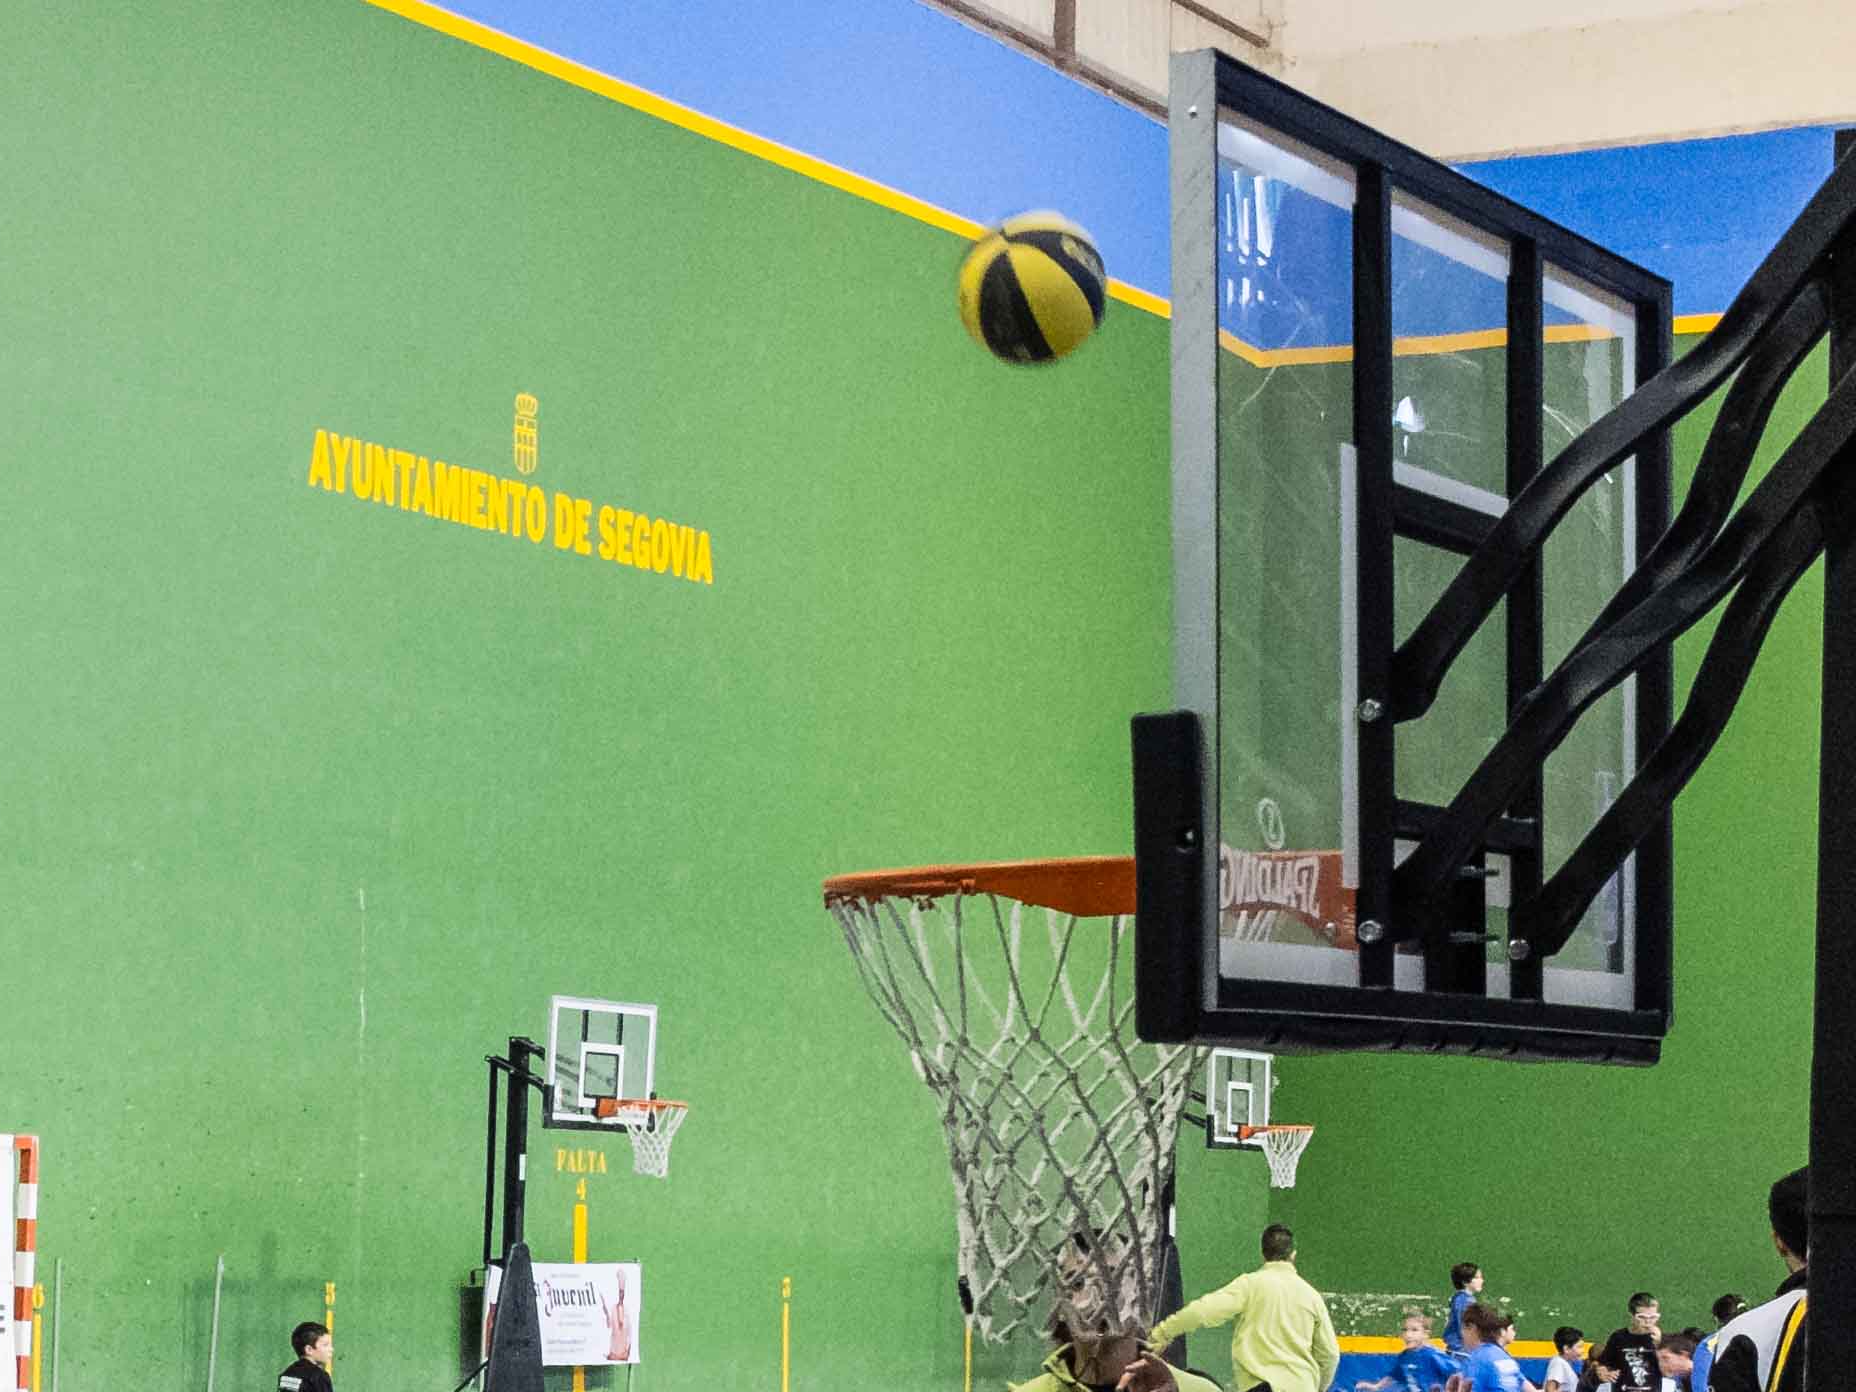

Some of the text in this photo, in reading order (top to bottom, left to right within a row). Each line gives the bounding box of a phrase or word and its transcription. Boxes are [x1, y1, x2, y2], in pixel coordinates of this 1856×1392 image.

[308, 428, 714, 585] AYUNTAMIENTO DE SEGOVIA
